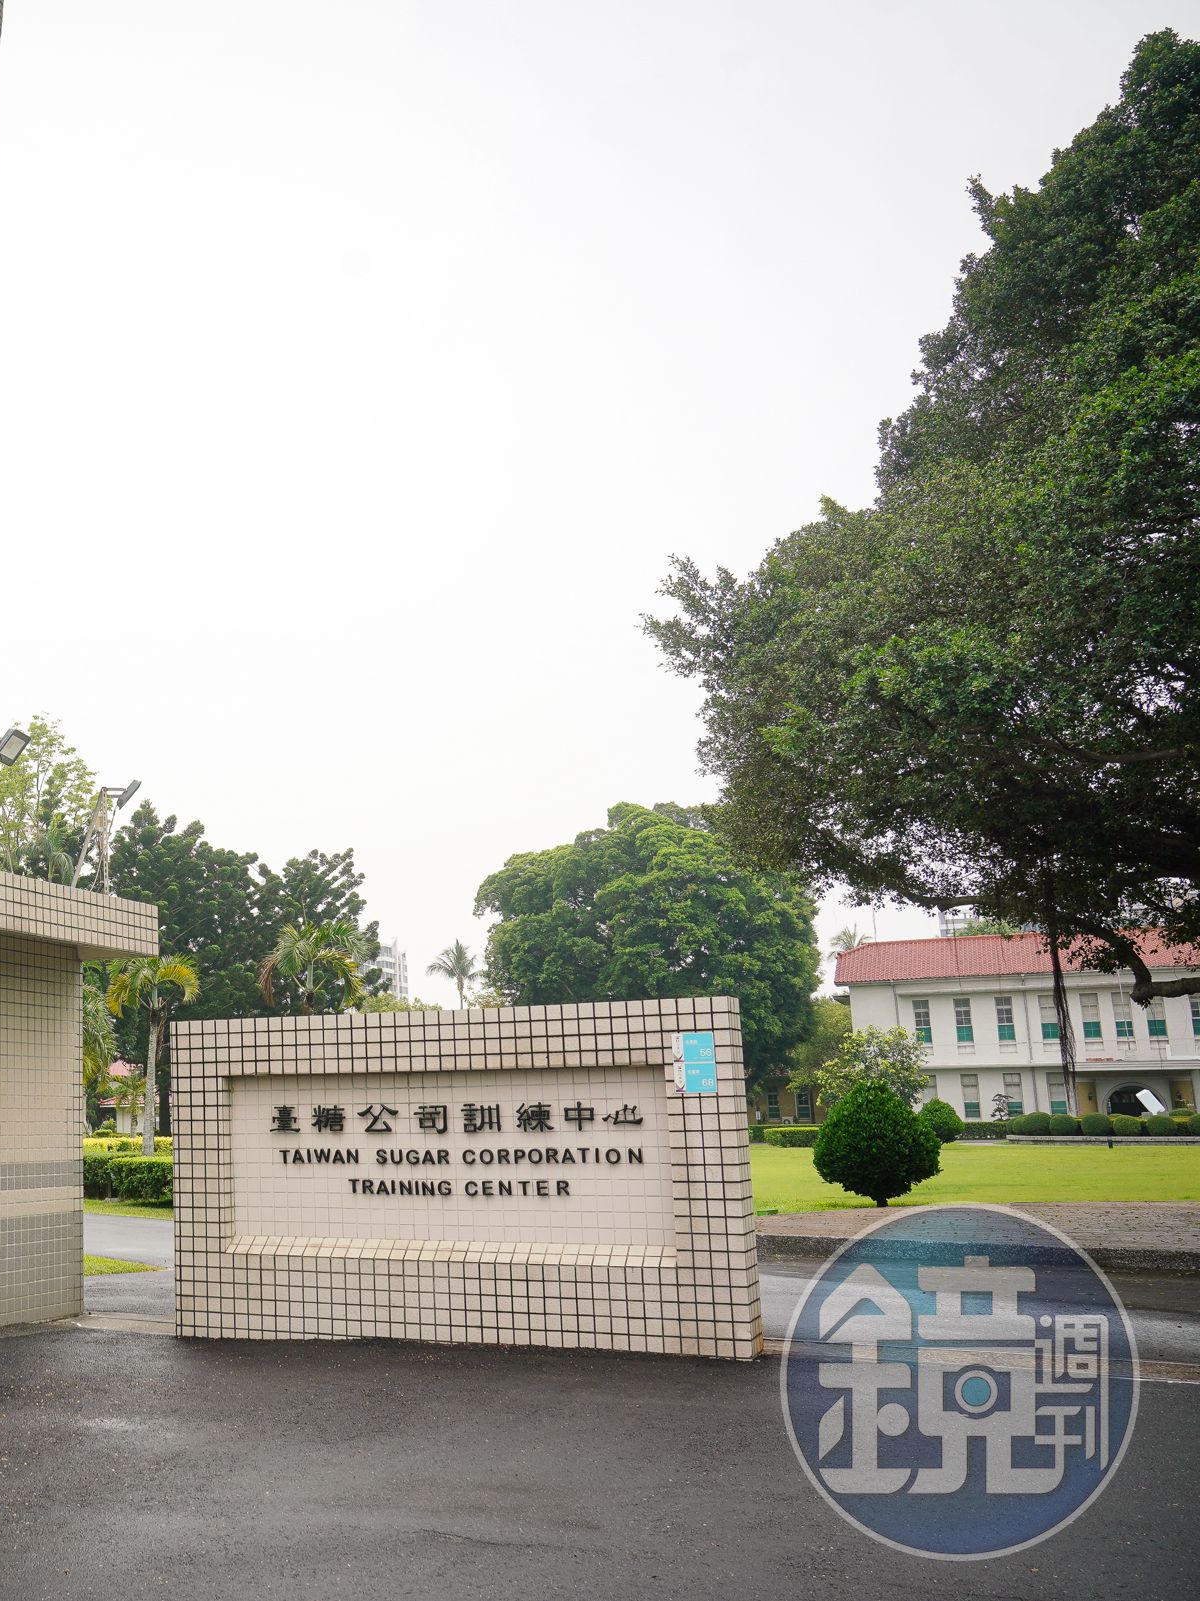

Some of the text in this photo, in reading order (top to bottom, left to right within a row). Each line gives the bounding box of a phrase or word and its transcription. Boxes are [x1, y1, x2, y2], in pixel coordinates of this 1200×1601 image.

[269, 1101, 644, 1134] 臺糖公司訓練中心
[279, 1147, 643, 1165] TAIWAN SUGAR CORPORATION
[348, 1178, 571, 1197] TRAINING CENTER
